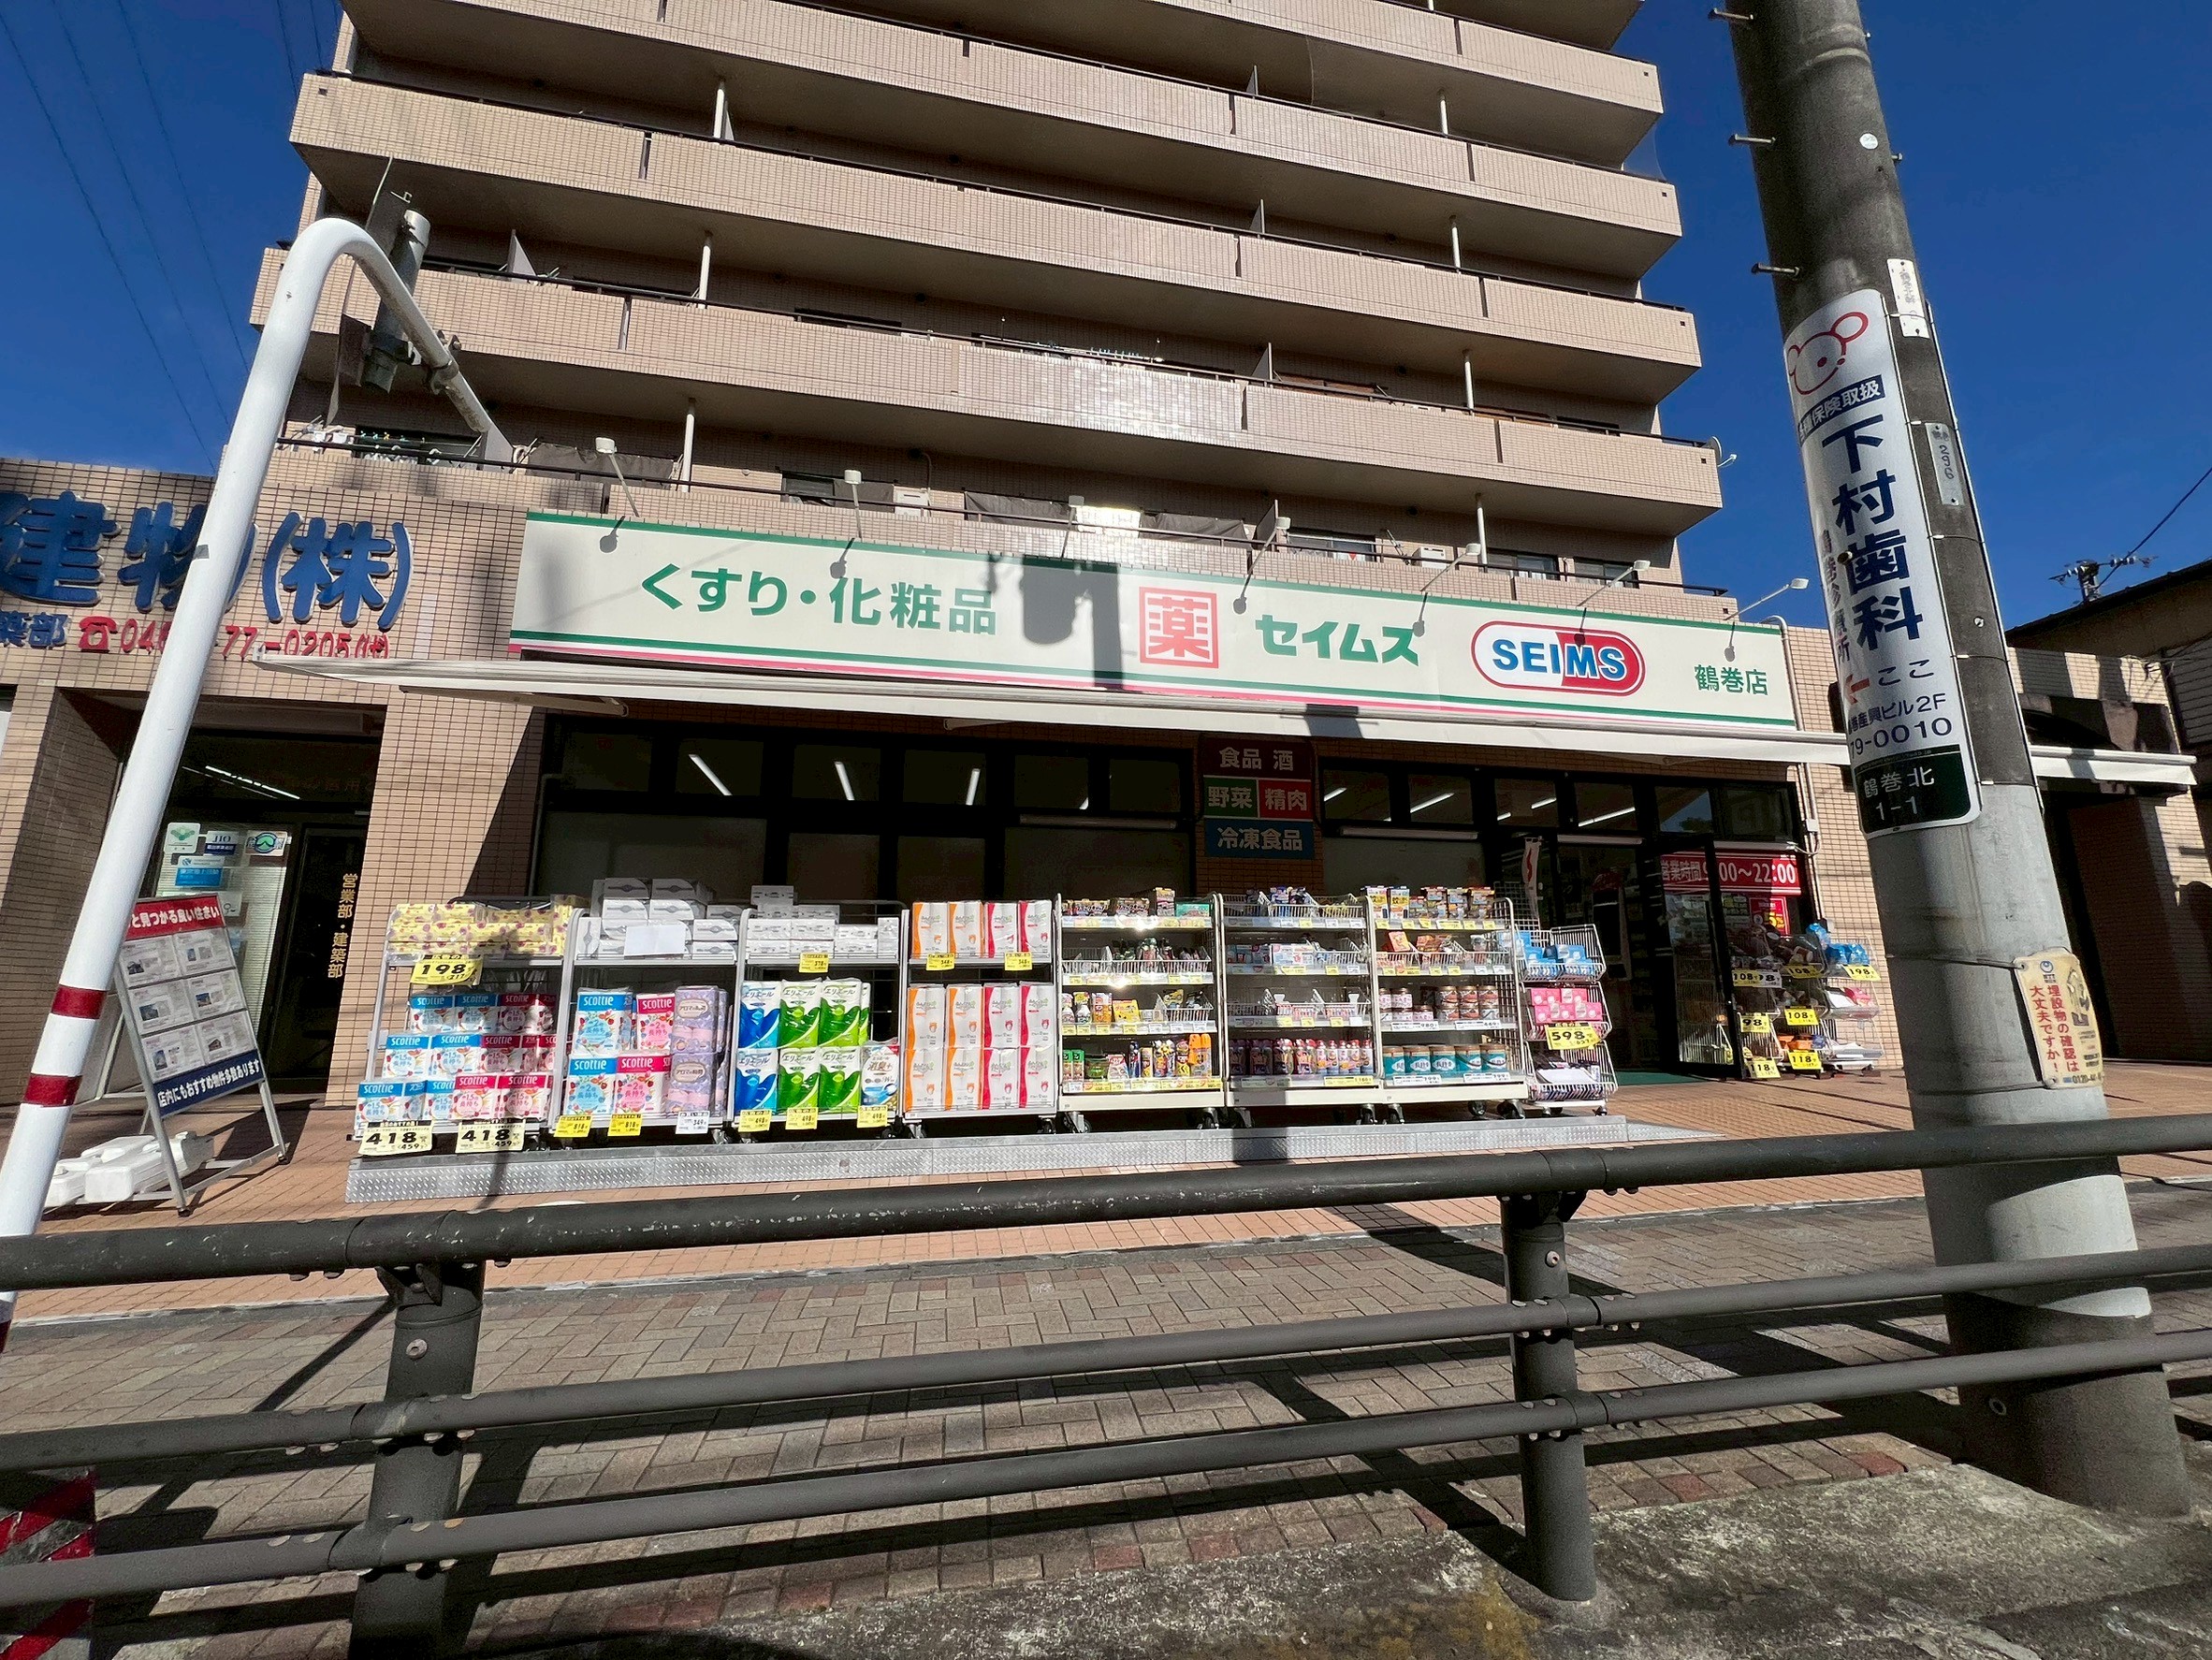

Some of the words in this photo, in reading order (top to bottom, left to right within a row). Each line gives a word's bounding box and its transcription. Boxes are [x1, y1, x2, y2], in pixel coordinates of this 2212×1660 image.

[1822, 415, 1923, 650] 下村歯科
[642, 562, 997, 635] くすり・化粧品
[1147, 595, 1213, 661] 薬
[1256, 614, 1419, 667] セイムス
[1492, 637, 1626, 682] SEIMS
[1694, 663, 1769, 696] 鶴巻店
[1878, 659, 1934, 687] ここ
[1219, 747, 1261, 769] 食品
[1273, 750, 1293, 771] 酒
[1863, 766, 1935, 798] 鶴巻北
[1208, 786, 1253, 808] 野菜
[1264, 788, 1308, 811] 精肉
[1875, 795, 1918, 821] 1-1
[1216, 826, 1303, 851] 冷凍食品
[1661, 859, 1702, 881] 営業時間
[128, 906, 220, 928] と見つかる良い住まい
[327, 873, 358, 979] 営業部・建築部
[422, 964, 466, 975] 198
[1551, 1031, 1585, 1041] 598
[2047, 984, 2079, 1072] 埋設物の確認は
[366, 1131, 417, 1144] 418
[461, 1129, 510, 1142] 418
